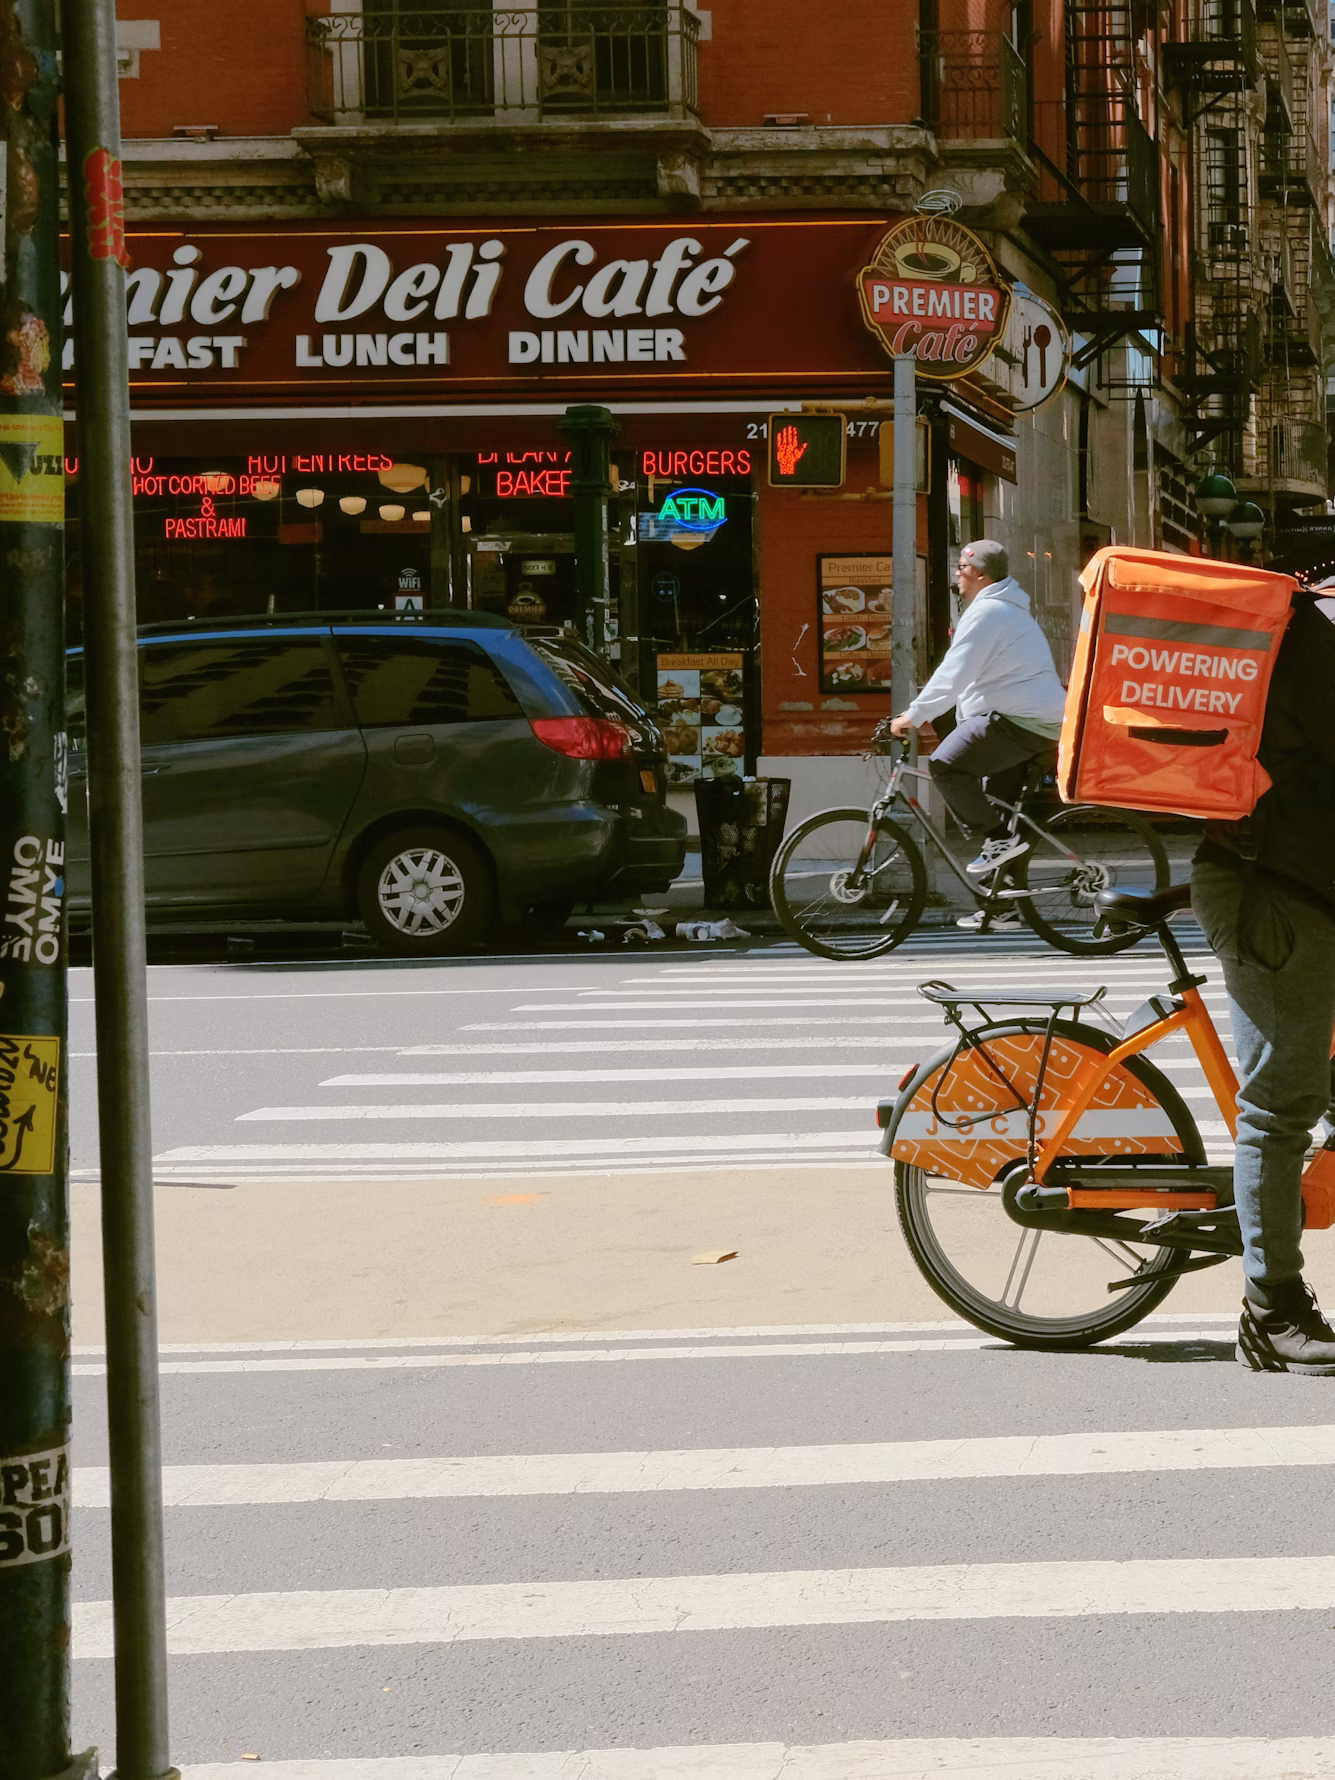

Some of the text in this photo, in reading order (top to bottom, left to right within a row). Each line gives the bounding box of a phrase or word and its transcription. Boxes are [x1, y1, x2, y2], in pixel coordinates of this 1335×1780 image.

[314, 238, 506, 324] Deli
[523, 236, 752, 319] Café
[872, 284, 996, 322] PREMIER
[295, 331, 450, 367] LUNCH
[507, 327, 690, 365] DINNER
[892, 320, 980, 364] Café
[642, 449, 752, 476] BURGERS
[132, 474, 283, 496] HOT CORNED BEEF
[200, 496, 216, 518] &
[657, 497, 726, 521] ATM
[164, 517, 248, 539] PASTRAMI
[828, 561, 893, 573] Premier Ca
[660, 656, 739, 669] Breakfast All Day
[1111, 643, 1259, 681] POWERING
[1120, 680, 1243, 715] DELIVERY
[925, 1114, 1046, 1136] JOCO
